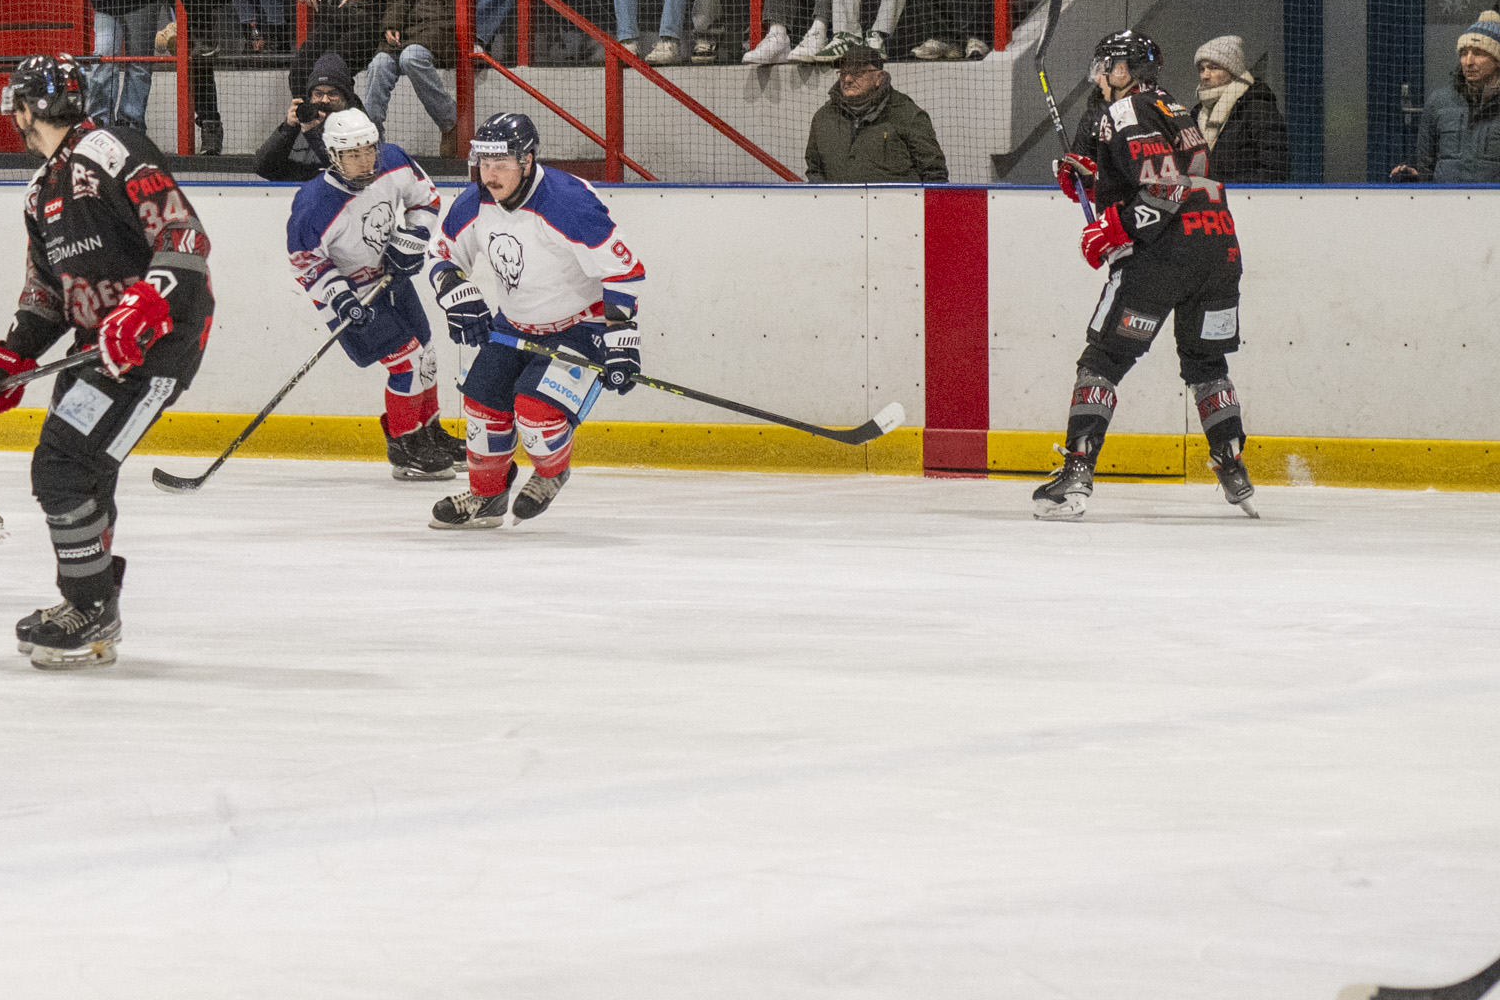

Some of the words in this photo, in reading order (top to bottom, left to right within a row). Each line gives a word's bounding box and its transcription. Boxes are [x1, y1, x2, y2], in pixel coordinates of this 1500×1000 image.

[1139, 155, 1180, 184] 44
[139, 189, 189, 247] 34
[611, 239, 633, 266] 9
[1128, 316, 1159, 332] KTM
[542, 377, 583, 407] POLYGON
